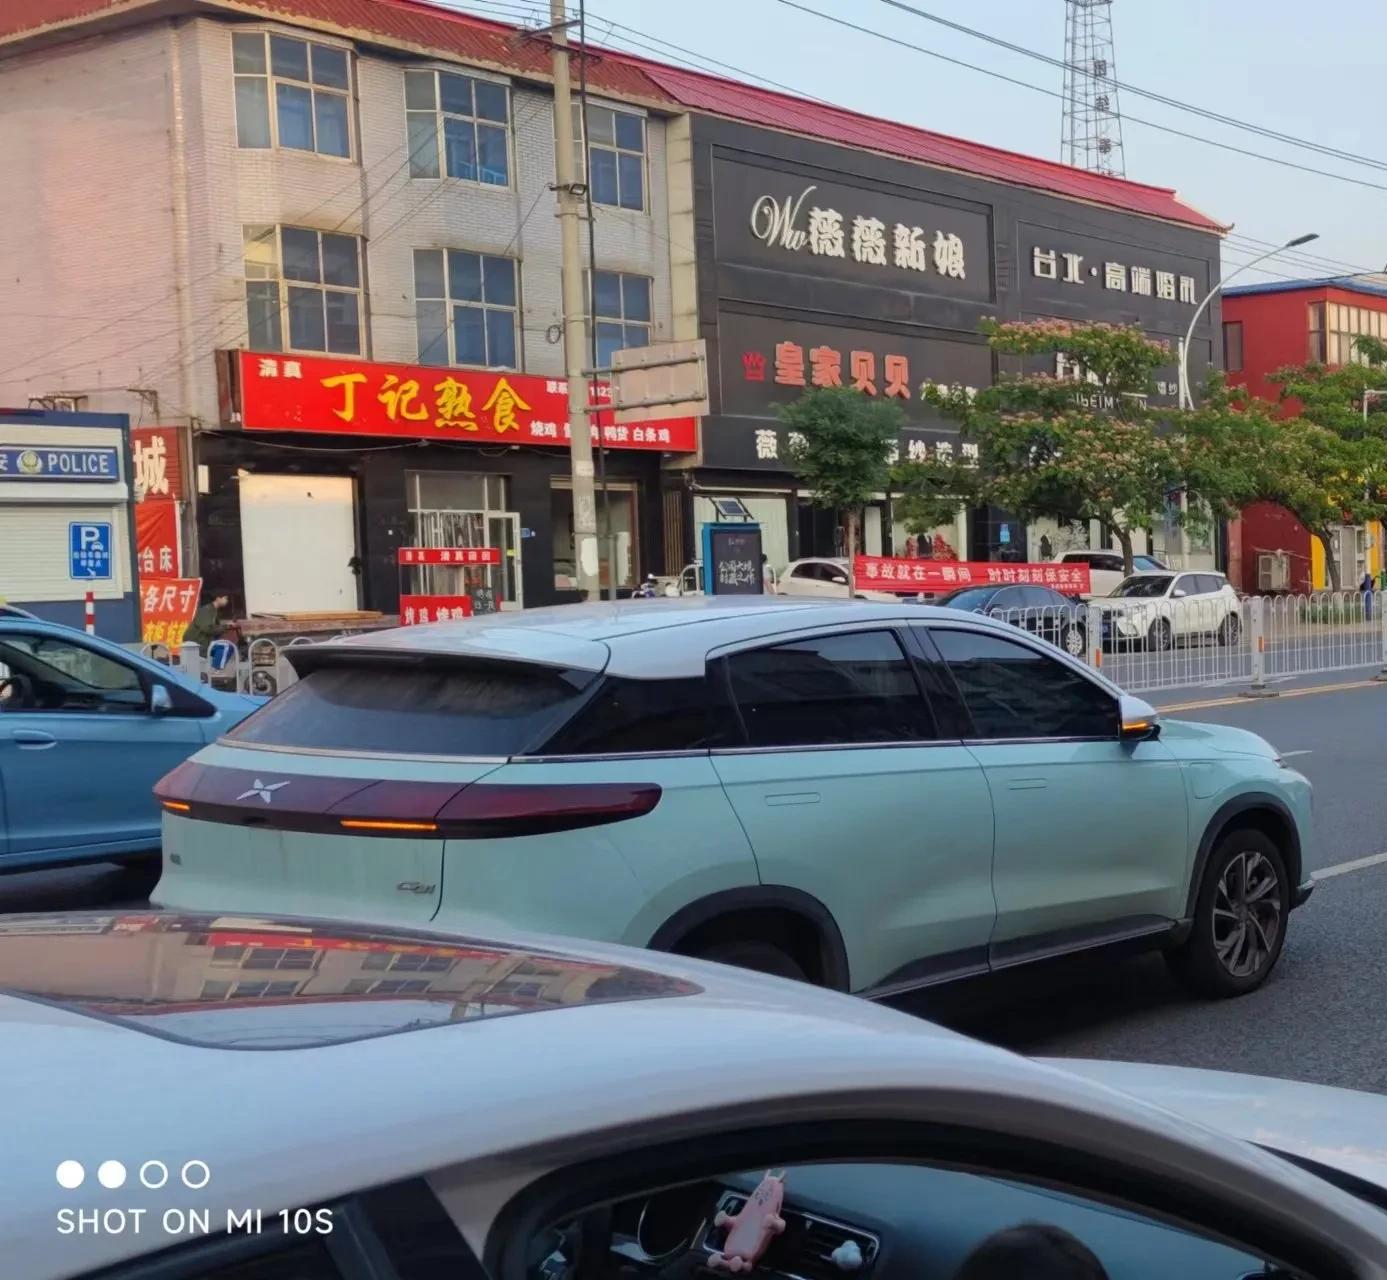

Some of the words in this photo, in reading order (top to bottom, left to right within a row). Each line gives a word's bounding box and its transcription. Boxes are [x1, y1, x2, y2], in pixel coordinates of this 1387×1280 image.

[807, 206, 966, 279] 薇薇新娘
[258, 358, 303, 379] 清真
[774, 341, 911, 400] 皇家贝贝
[320, 373, 532, 434] 丁记熟食
[633, 428, 670, 443] 白条鸡
[48, 453, 109, 473] POLICE
[133, 436, 169, 502] 城
[81, 526, 100, 550] P
